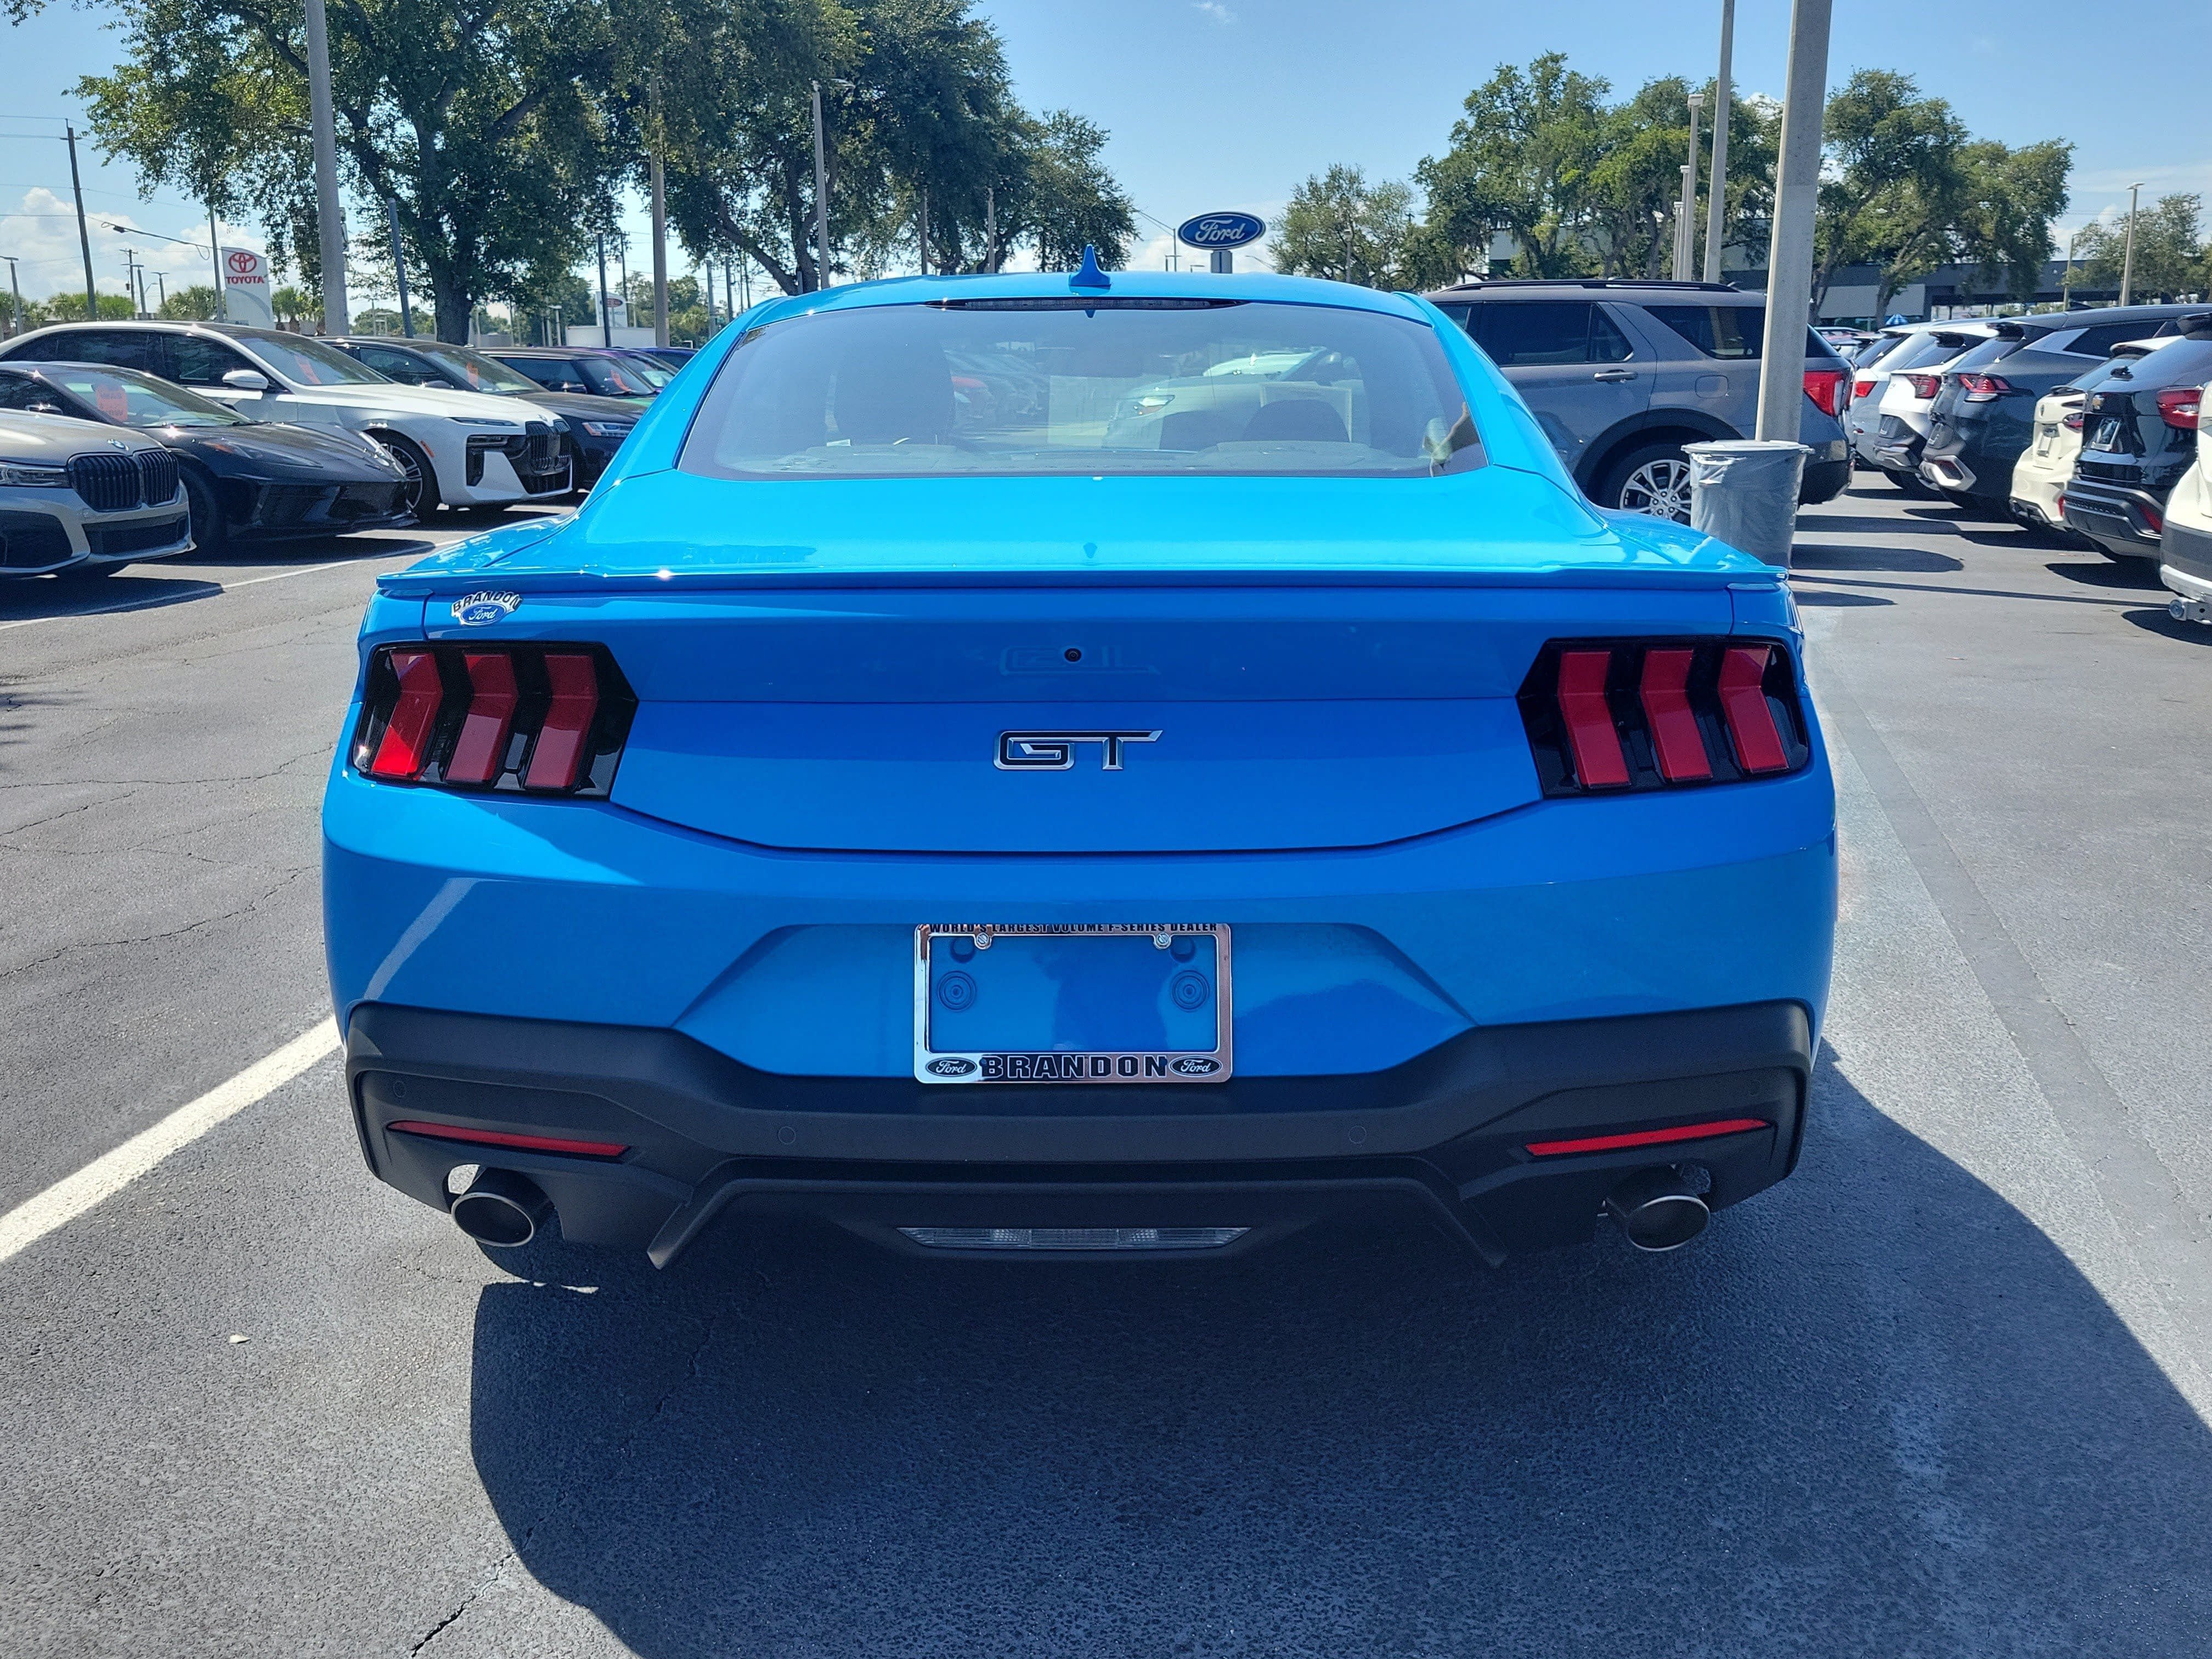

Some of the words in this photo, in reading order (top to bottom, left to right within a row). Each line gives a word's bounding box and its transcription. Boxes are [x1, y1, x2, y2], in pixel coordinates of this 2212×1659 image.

[1195, 219, 1246, 242] Ford
[226, 276, 265, 284] TOYOTA
[453, 591, 522, 613] BRANDON
[469, 606, 498, 620] Ford
[994, 730, 1163, 770] GT
[930, 923, 987, 933] WORLD'S
[992, 923, 1048, 933] LARGEST
[1052, 923, 1104, 932] VOLUME
[1108, 923, 1166, 932] F-SERIES
[1170, 923, 1217, 932] DEALER
[936, 1060, 967, 1074] Ford
[981, 1055, 1167, 1078] BRANDON
[1181, 1059, 1211, 1073] Ford
